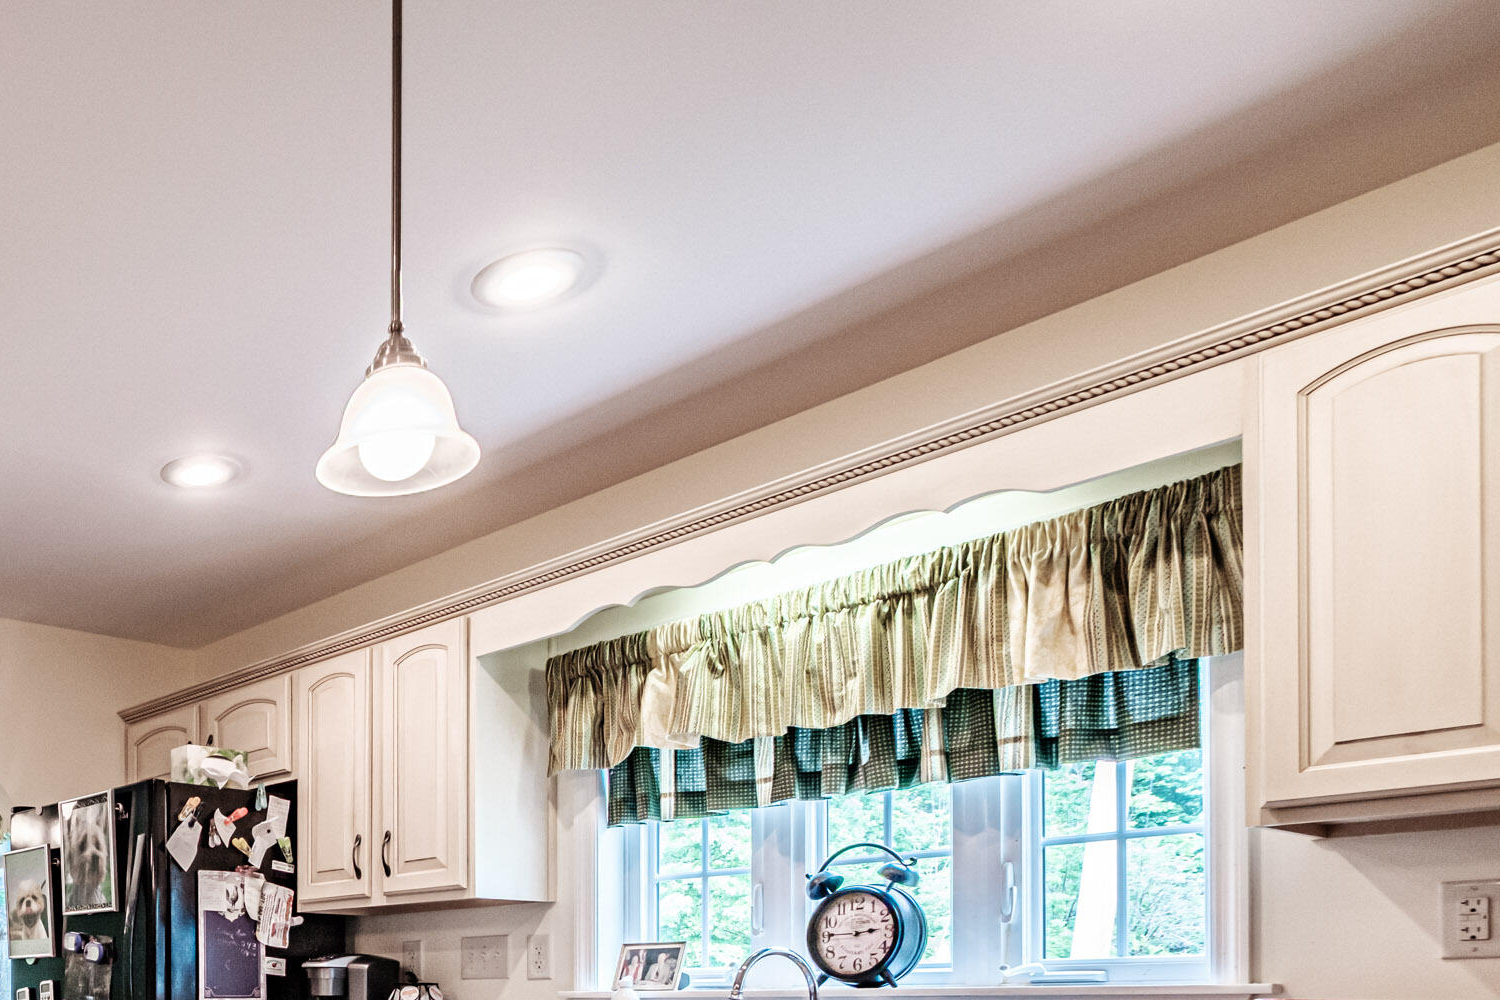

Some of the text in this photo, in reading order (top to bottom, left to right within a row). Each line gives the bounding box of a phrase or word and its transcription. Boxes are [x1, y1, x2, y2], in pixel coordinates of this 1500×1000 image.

[837, 902, 846, 916] 11
[850, 896, 866, 911] 12
[871, 899, 876, 913] 1
[825, 915, 838, 929] 10
[880, 909, 890, 923] 2
[822, 931, 831, 944] 9
[884, 924, 894, 939] 3
[825, 946, 836, 959] 8
[878, 940, 890, 954] 4
[838, 955, 847, 969] 7
[853, 957, 863, 972] 6
[869, 952, 879, 966] 5
